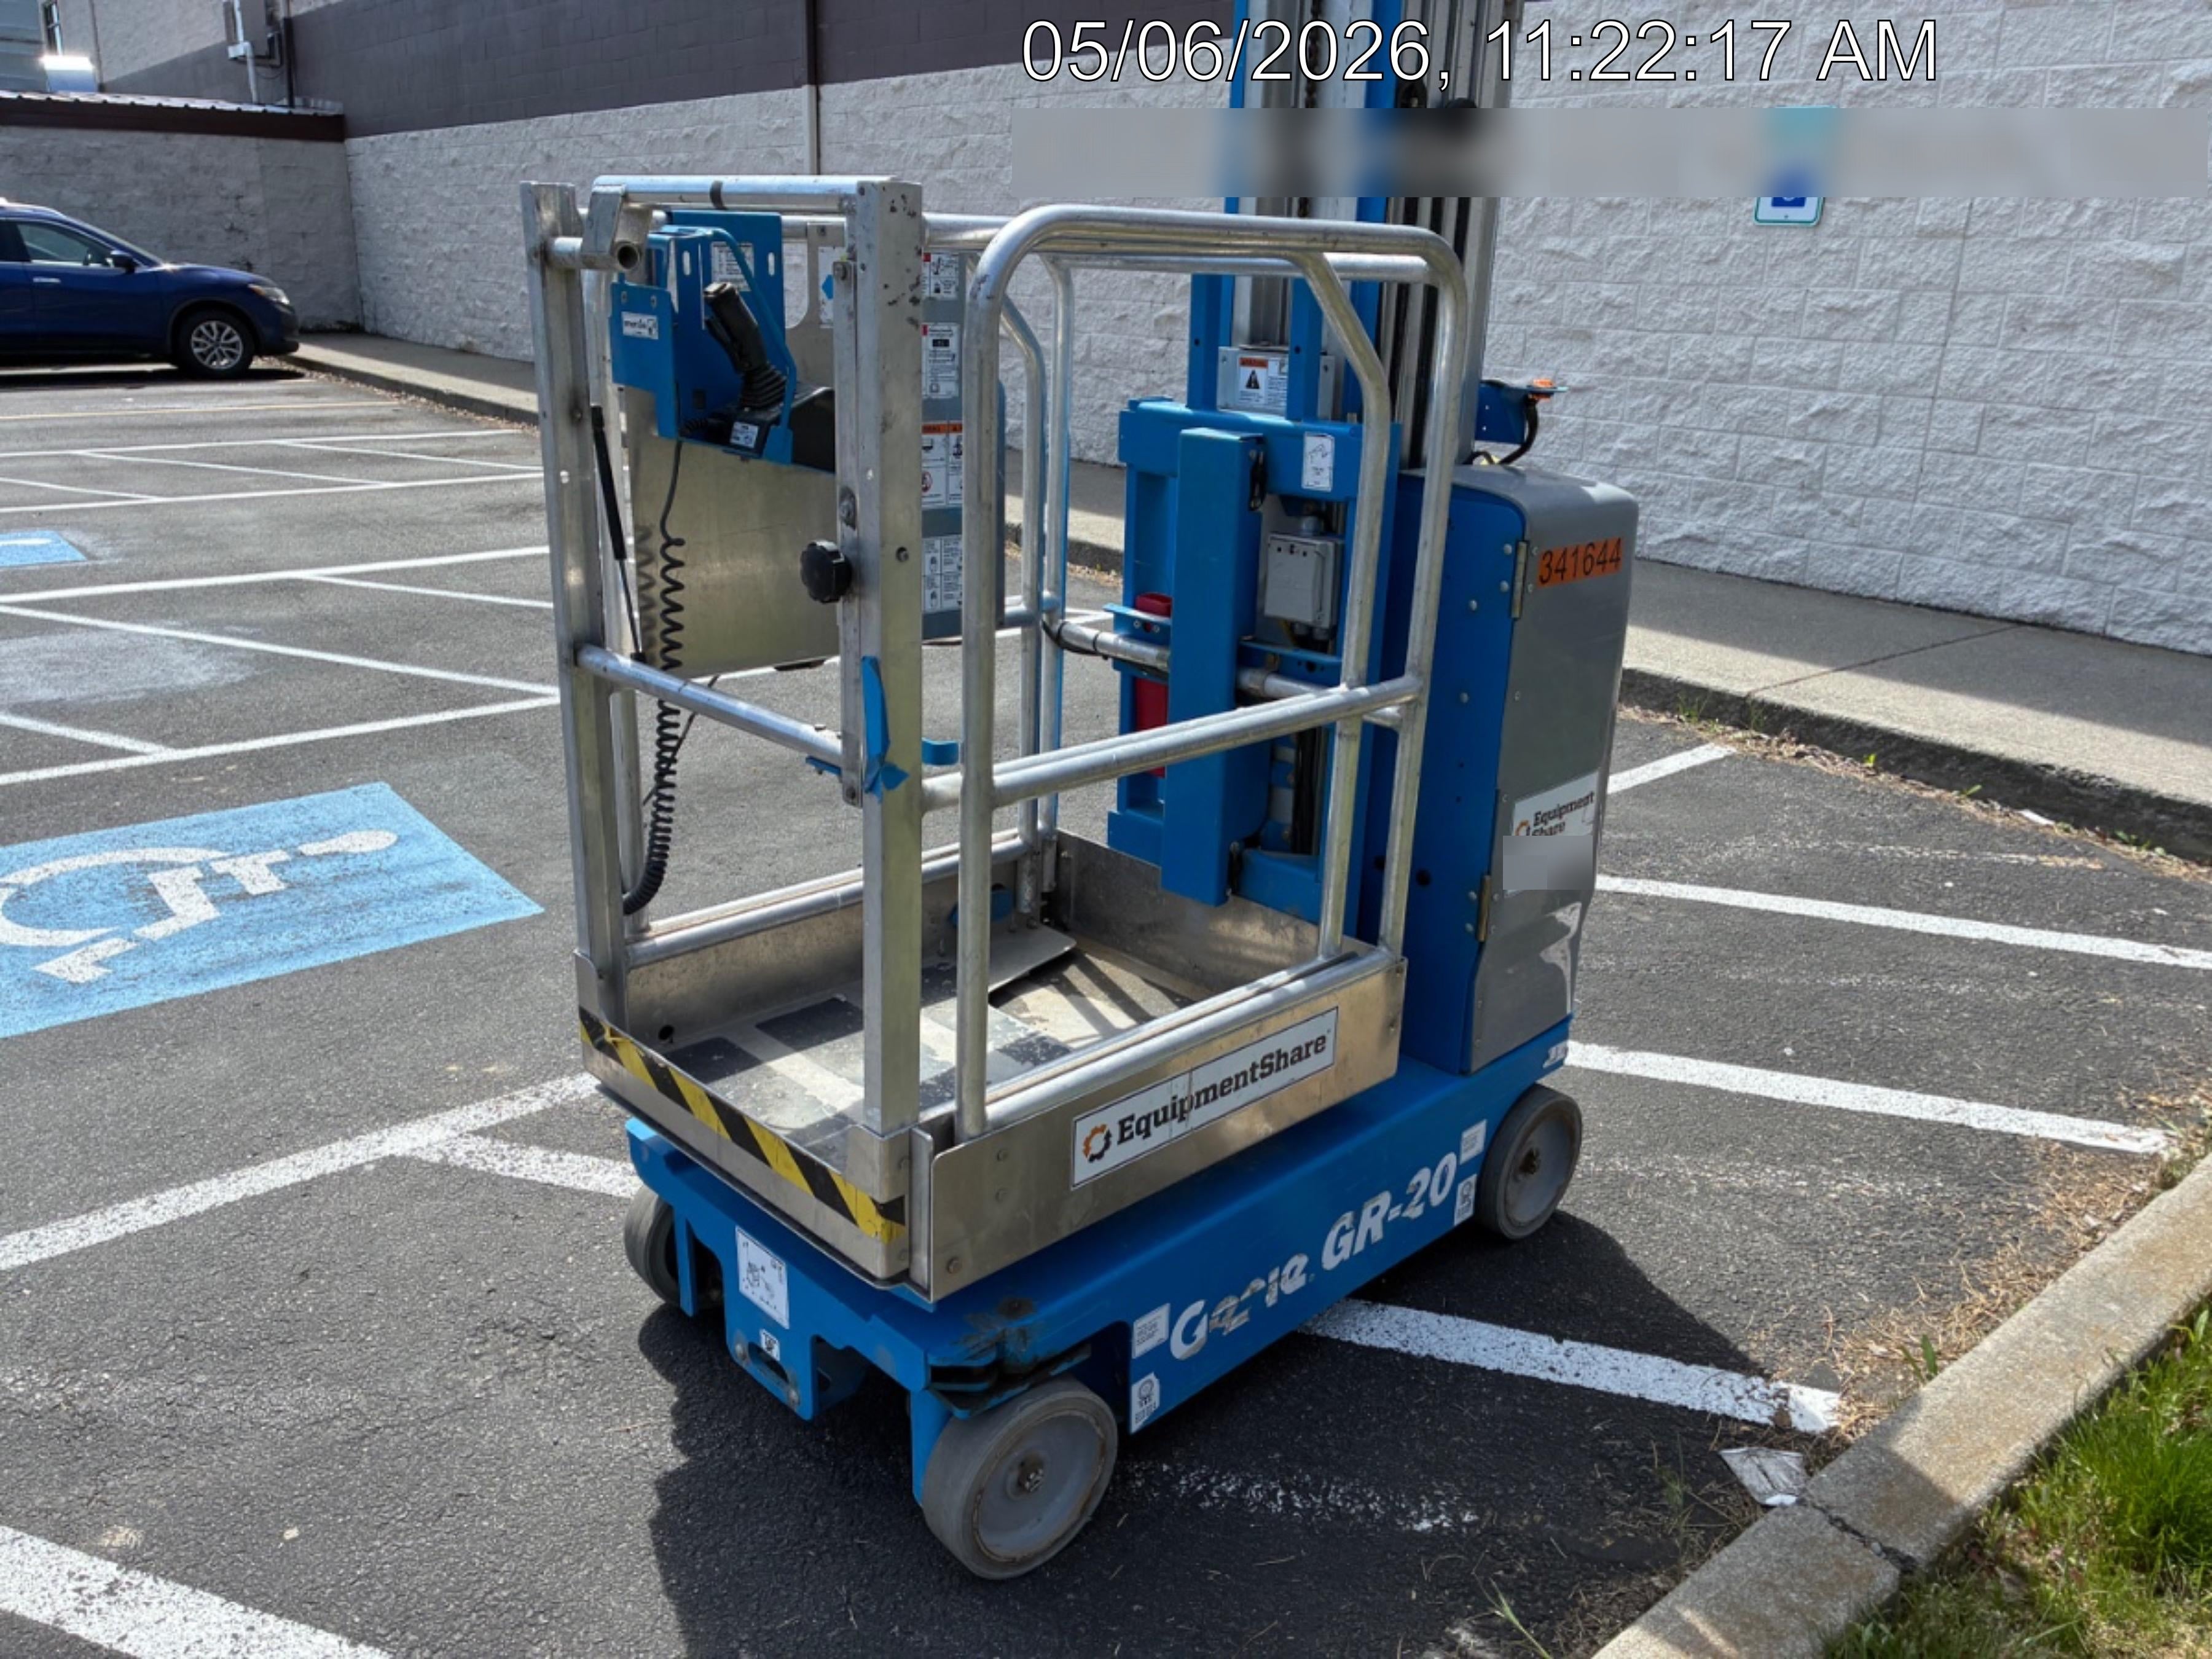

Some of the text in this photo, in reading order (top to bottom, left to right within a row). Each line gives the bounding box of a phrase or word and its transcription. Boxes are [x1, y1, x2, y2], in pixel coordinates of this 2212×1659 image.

[1539, 537, 1622, 584] 341644
[1533, 791, 1594, 827] Equipment
[1116, 1034, 1326, 1145] EquipmentShare
[1322, 1151, 1457, 1271] GR-20
